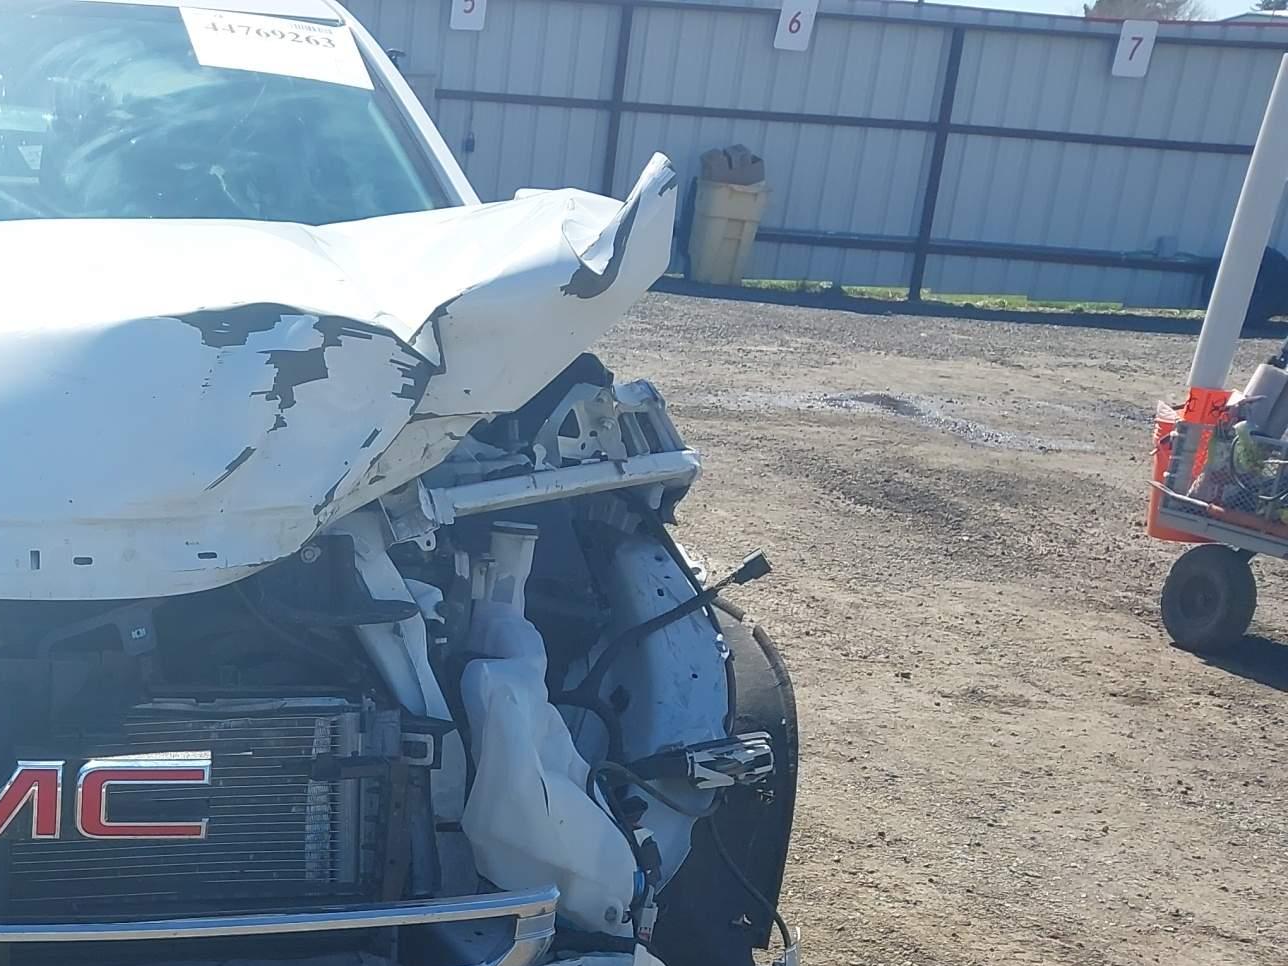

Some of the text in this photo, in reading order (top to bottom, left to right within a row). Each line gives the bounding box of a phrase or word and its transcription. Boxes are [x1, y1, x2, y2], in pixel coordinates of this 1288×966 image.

[204, 20, 336, 49] 44769263
[789, 11, 801, 34] 6
[1129, 36, 1143, 61] 7
